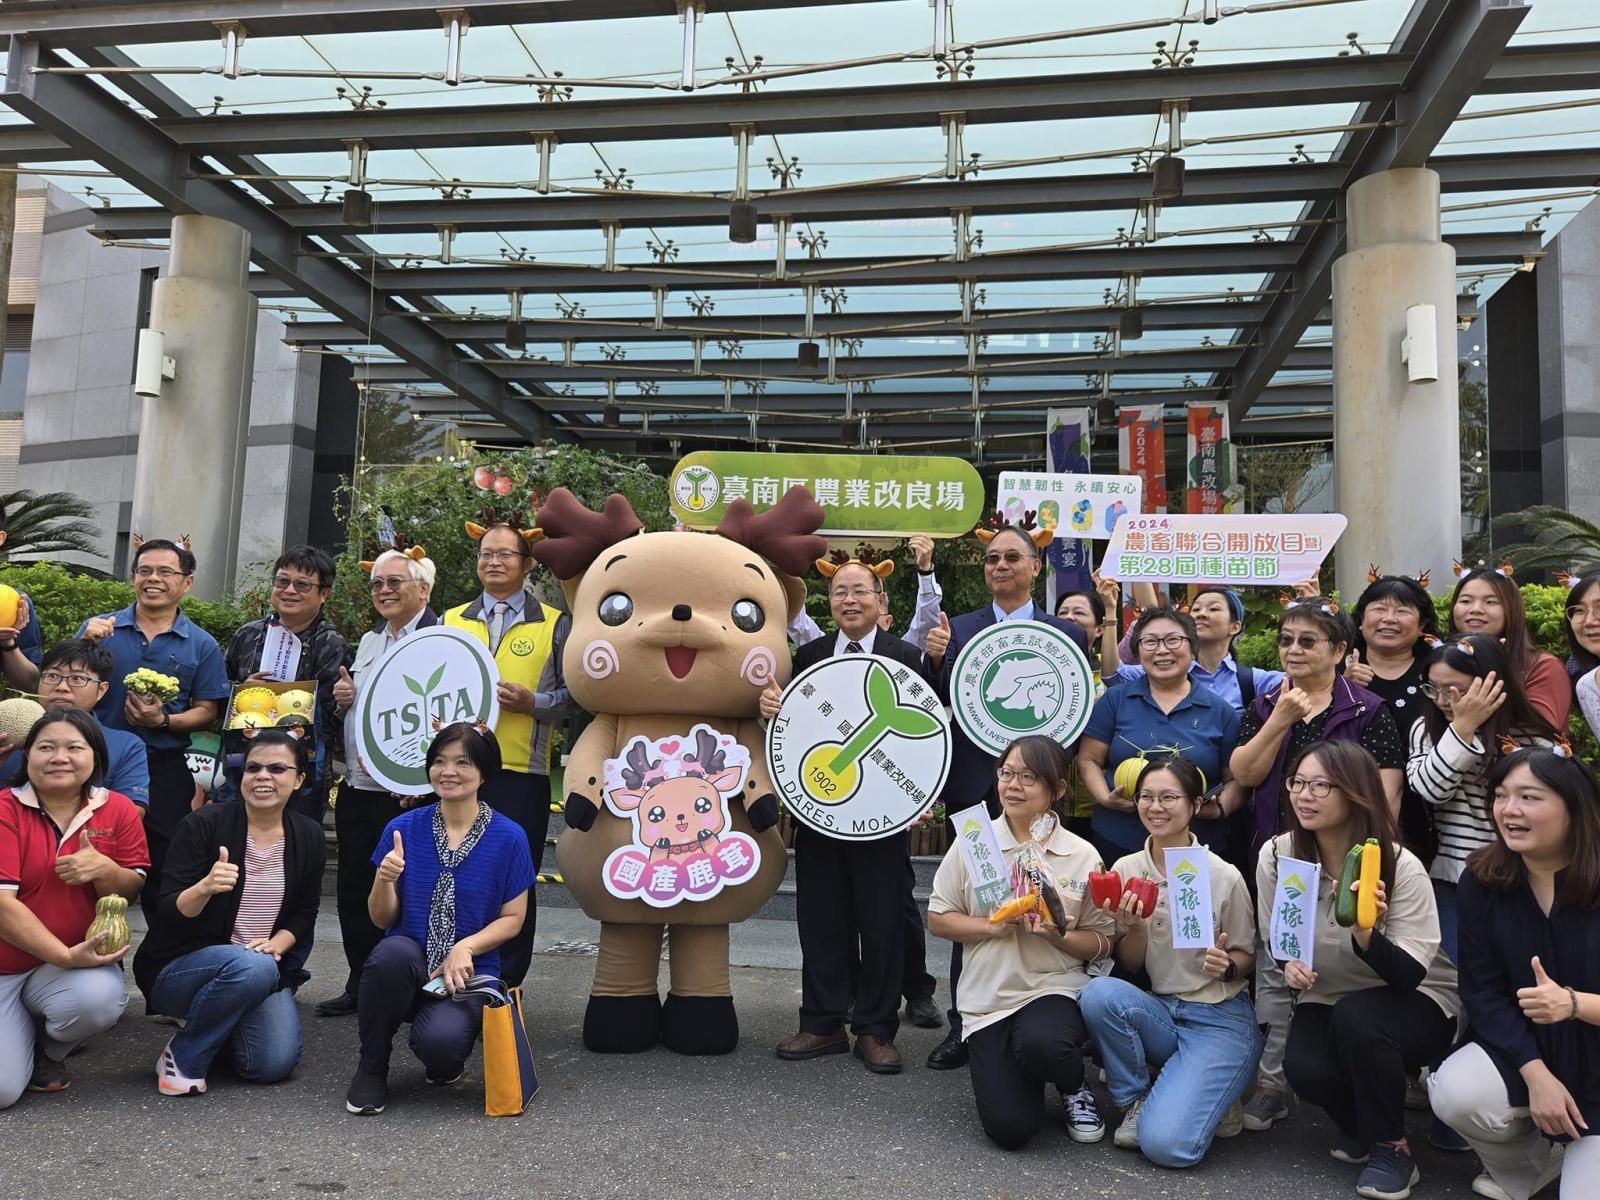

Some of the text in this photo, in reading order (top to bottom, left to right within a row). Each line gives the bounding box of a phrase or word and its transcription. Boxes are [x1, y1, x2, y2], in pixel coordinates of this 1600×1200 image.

[1136, 426, 1146, 465] 2024
[1003, 478, 1137, 495] 智慧韌性 永續安心
[1128, 518, 1169, 530] 2024
[1119, 555, 1278, 577] 第28屆種苗節
[964, 632, 1073, 688] 農業部畜產試驗所
[891, 667, 939, 713] 農業部
[966, 701, 986, 729] TAIWAN
[984, 728, 1010, 745] LIVEST
[1066, 681, 1080, 721] INSTITUTE
[773, 715, 894, 833] Tainan DARES, MOA
[808, 766, 837, 796] 1902
[869, 748, 928, 805] 農業改良場
[613, 840, 751, 893] 國產鹿茸
